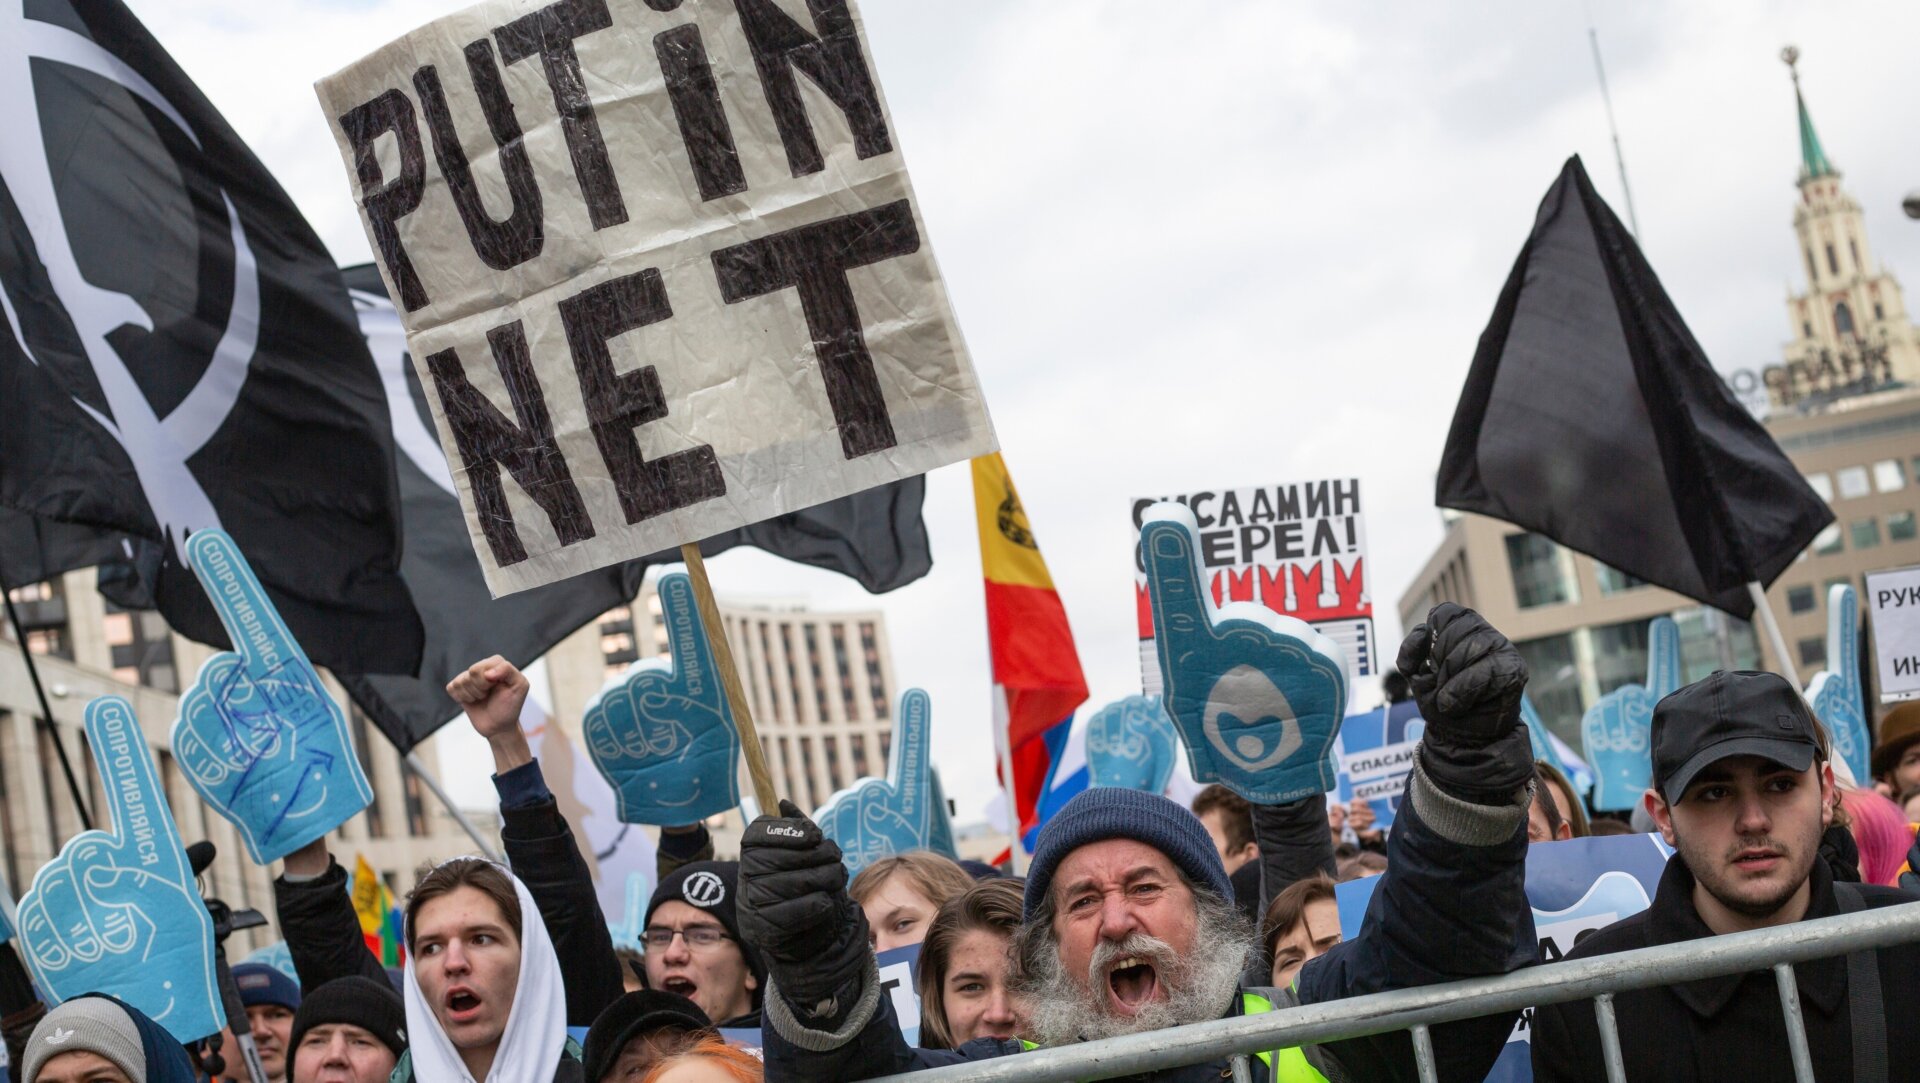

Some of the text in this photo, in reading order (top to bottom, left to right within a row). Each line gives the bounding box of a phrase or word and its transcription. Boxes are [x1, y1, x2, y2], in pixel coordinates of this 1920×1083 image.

[425, 198, 921, 568] NET
[202, 541, 285, 676] СОПРОТИВЛЯЙСЯ
[1135, 515, 1358, 573] ЕРЕЛ!
[670, 580, 704, 696] СОПРОТИВЛЯЙСЯ
[102, 707, 160, 866] СОПРОТИВЛЯЙСЯ
